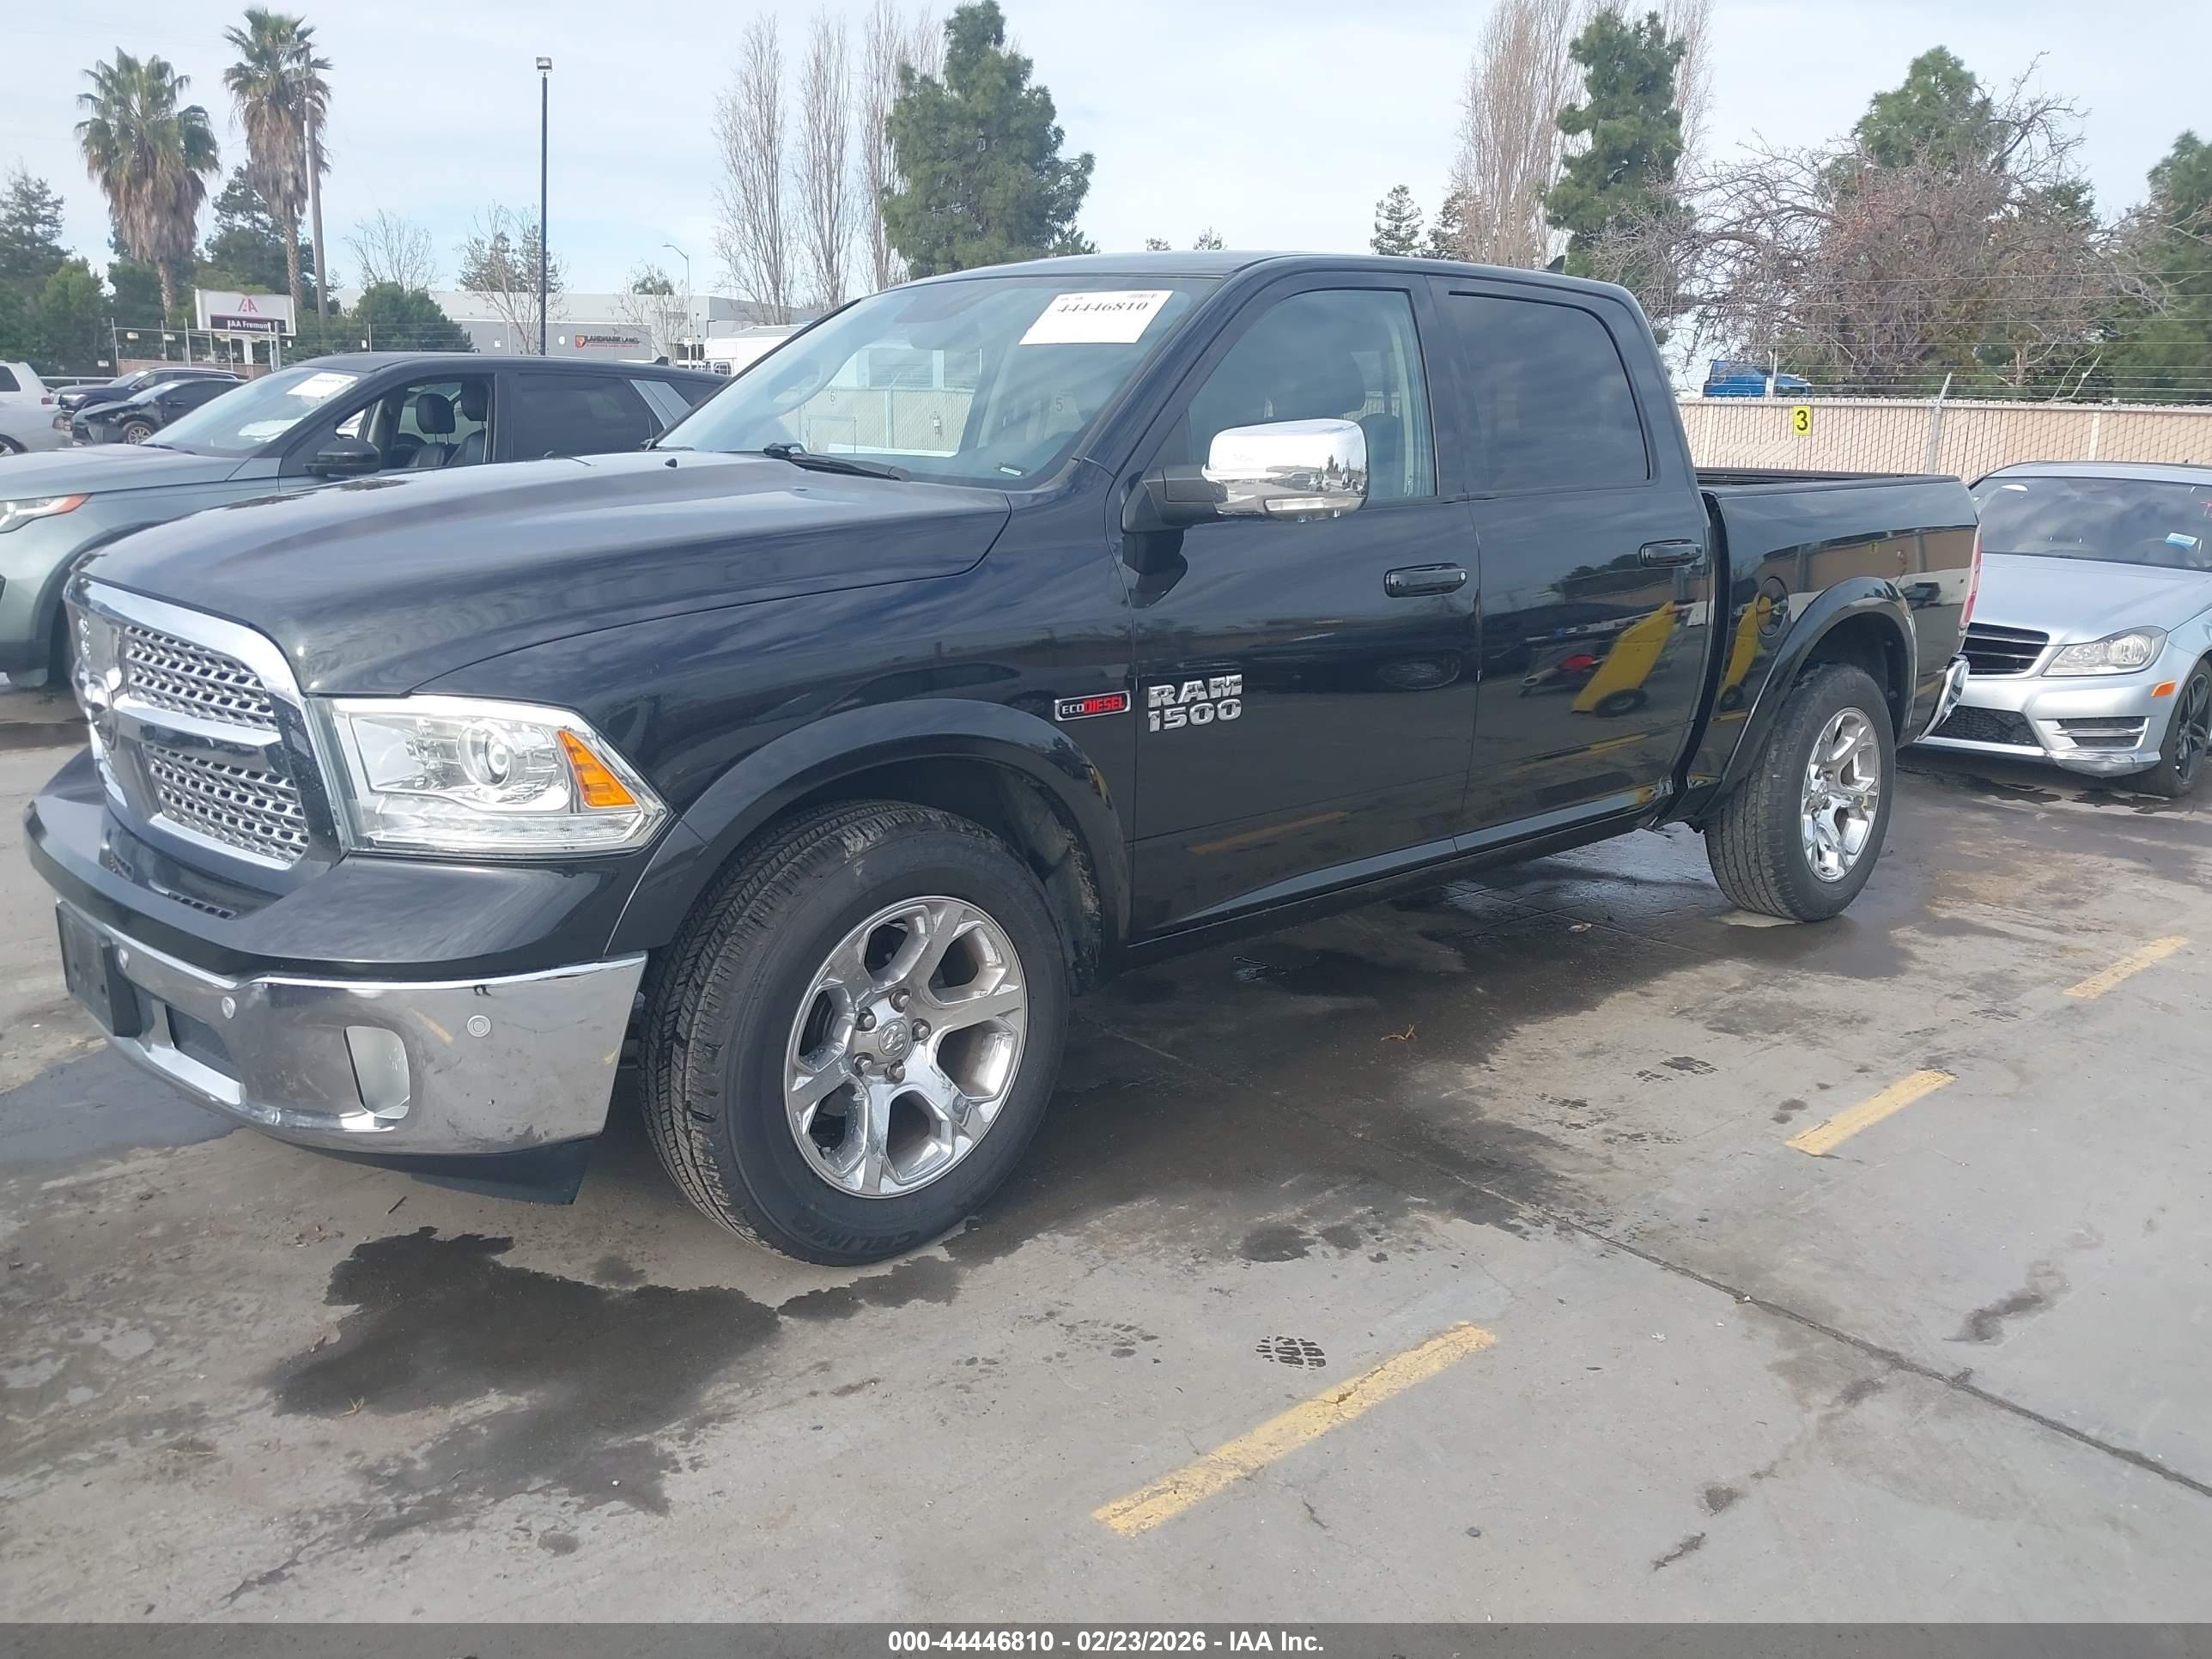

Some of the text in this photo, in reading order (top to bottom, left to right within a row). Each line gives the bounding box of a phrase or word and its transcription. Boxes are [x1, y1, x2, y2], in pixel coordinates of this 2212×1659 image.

[1058, 301, 1148, 313] 44446810
[830, 391, 836, 403] 6
[1796, 410, 1808, 430] 3
[1148, 674, 1243, 708] RAM
[1148, 698, 1242, 732] 1500
